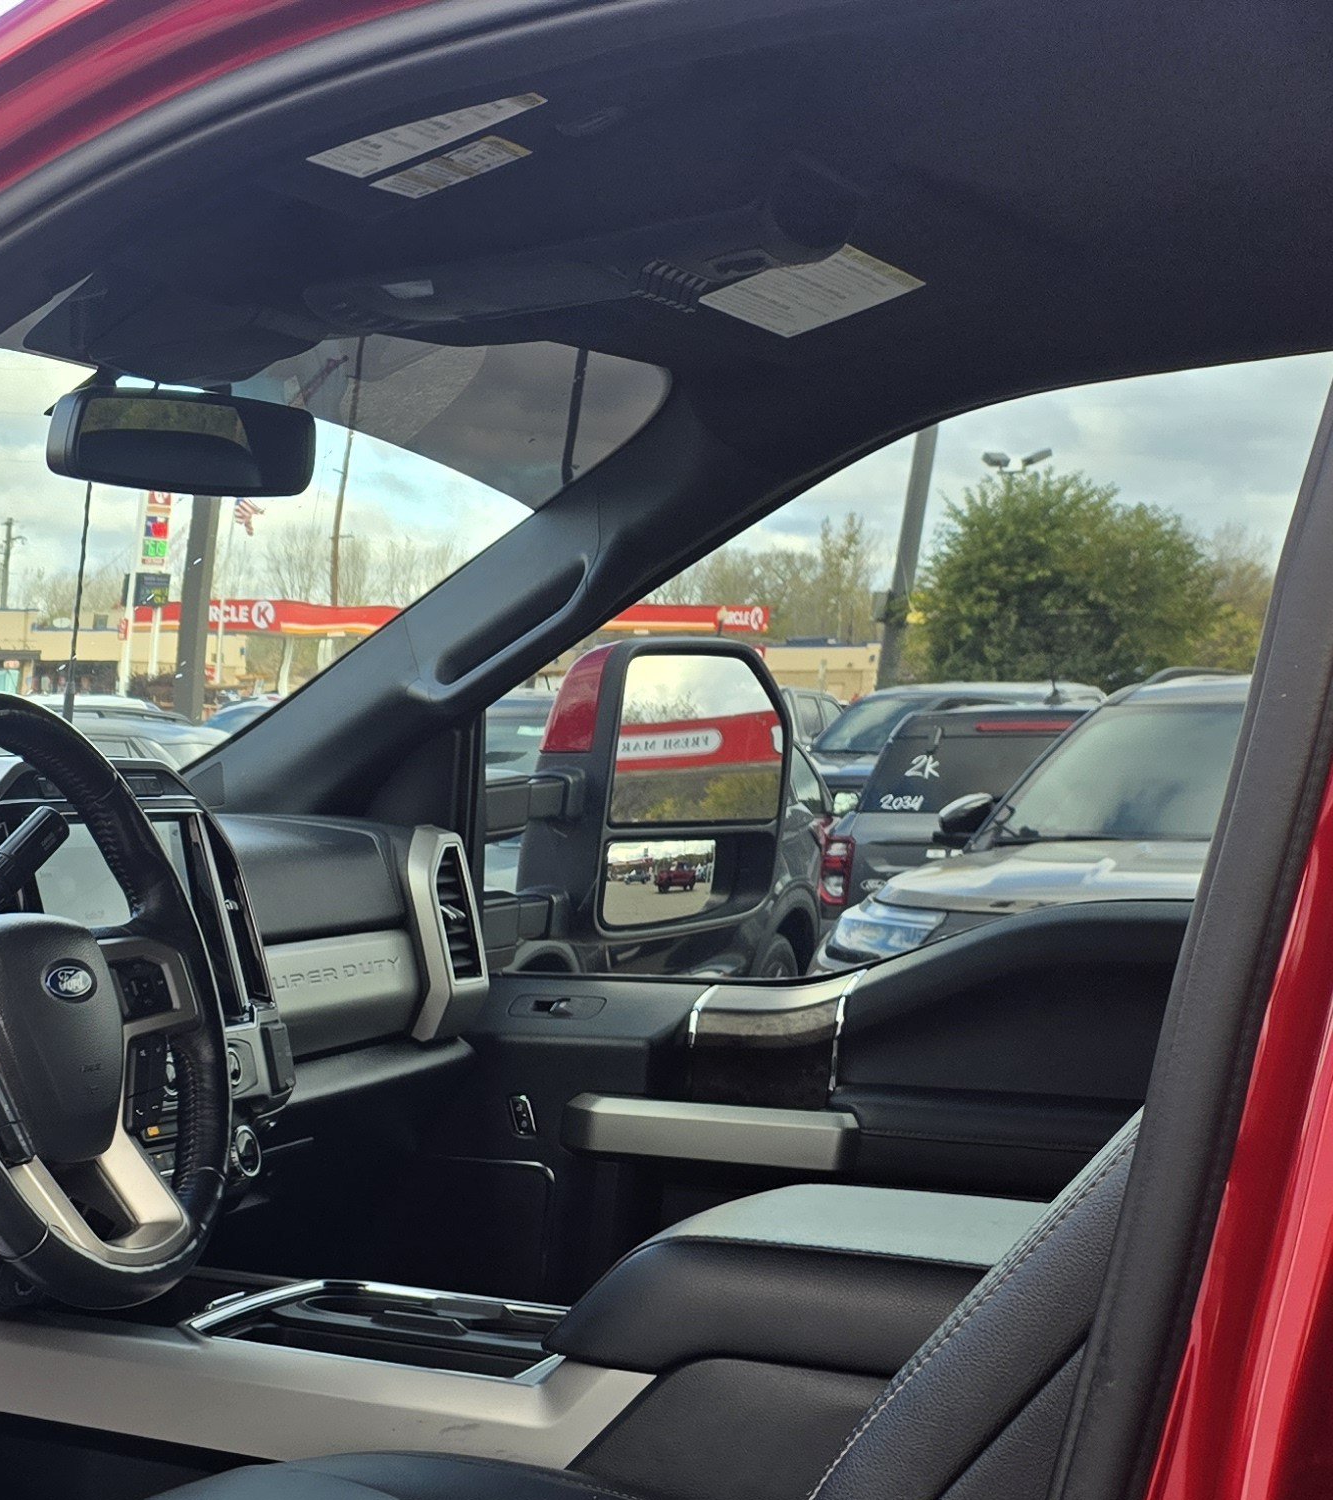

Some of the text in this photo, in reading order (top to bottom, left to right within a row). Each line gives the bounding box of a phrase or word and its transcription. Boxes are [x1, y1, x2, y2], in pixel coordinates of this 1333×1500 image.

[209, 600, 275, 629] RCLE K
[880, 793, 925, 812] 2034
[57, 968, 86, 992] Ford
[272, 955, 400, 990] UPER DUTY
